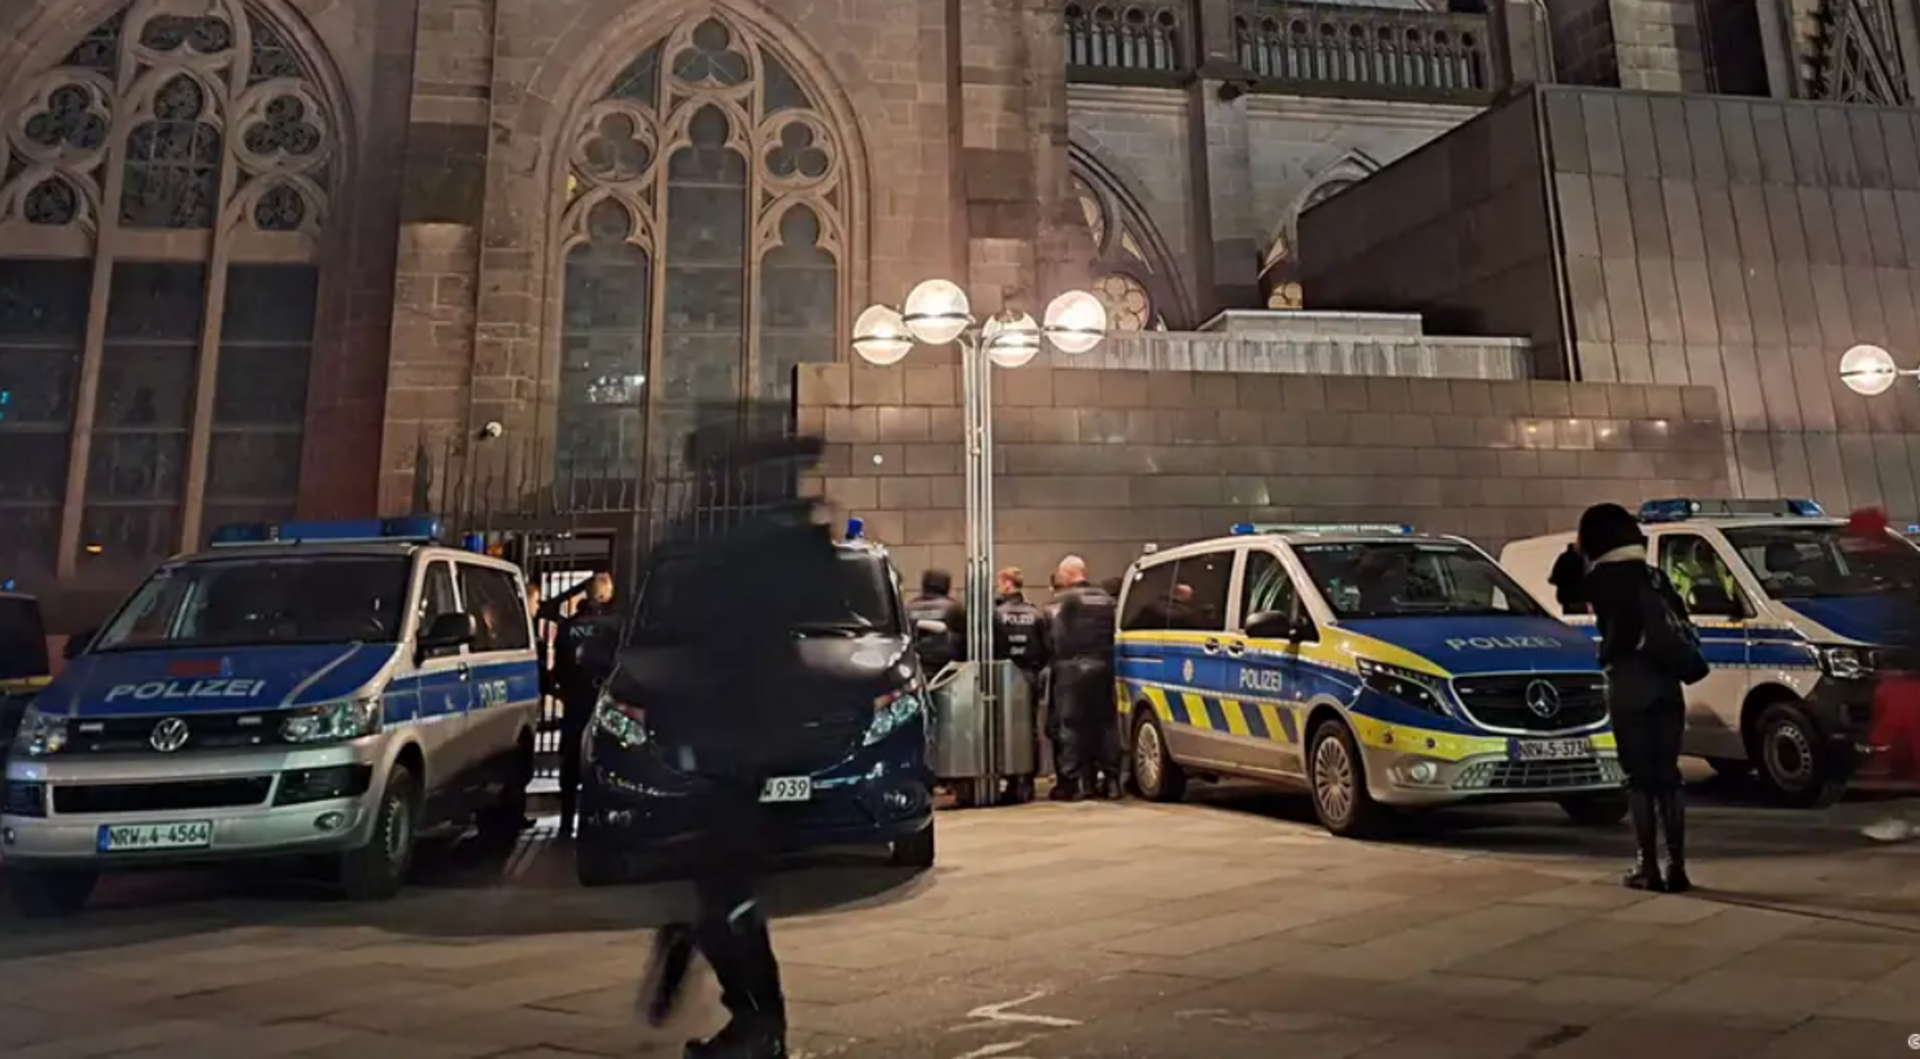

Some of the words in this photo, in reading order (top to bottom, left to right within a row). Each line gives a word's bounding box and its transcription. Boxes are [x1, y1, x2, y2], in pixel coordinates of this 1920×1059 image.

[1444, 636, 1561, 651] POLIZEI
[1239, 667, 1282, 692] POLIZEI
[103, 679, 266, 702] POLIZEI
[776, 779, 808, 798] 939
